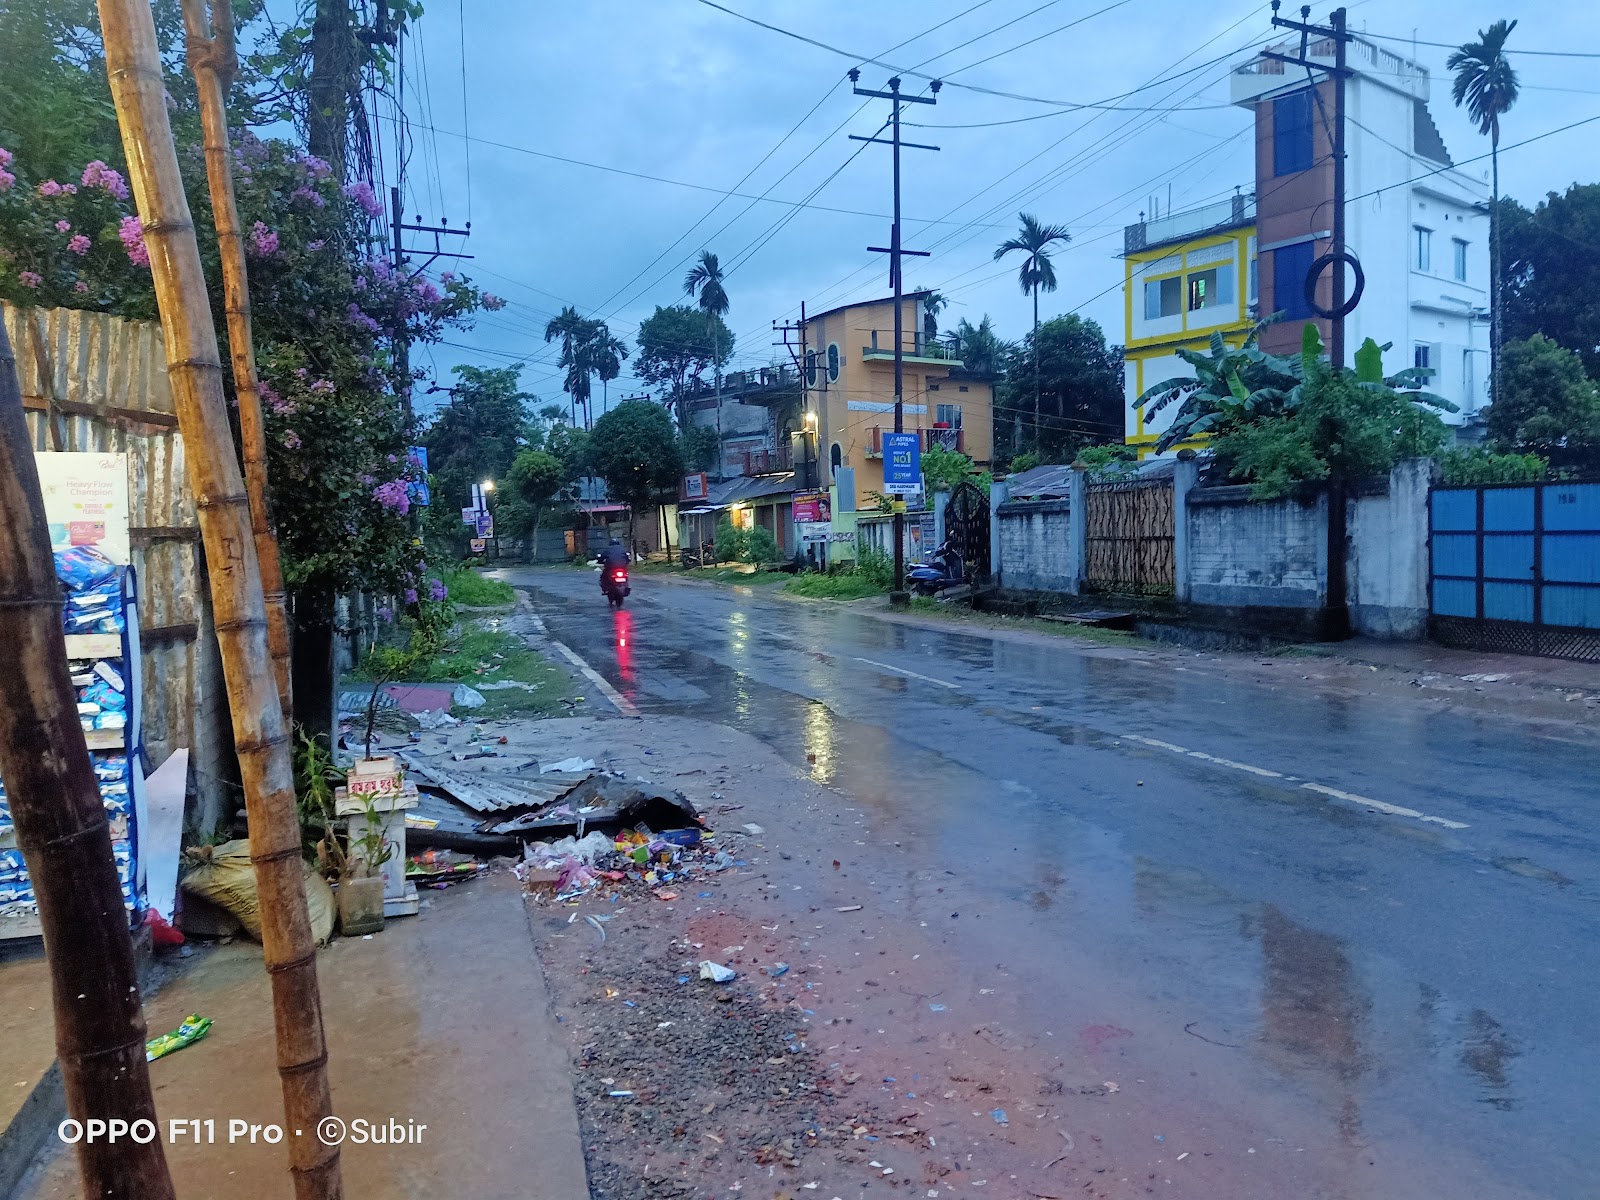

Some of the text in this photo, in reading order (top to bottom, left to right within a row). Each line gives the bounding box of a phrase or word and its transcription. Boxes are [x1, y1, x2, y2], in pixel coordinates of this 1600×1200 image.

[66, 480, 113, 489] Heavy Flow
[70, 488, 113, 497] Champion
